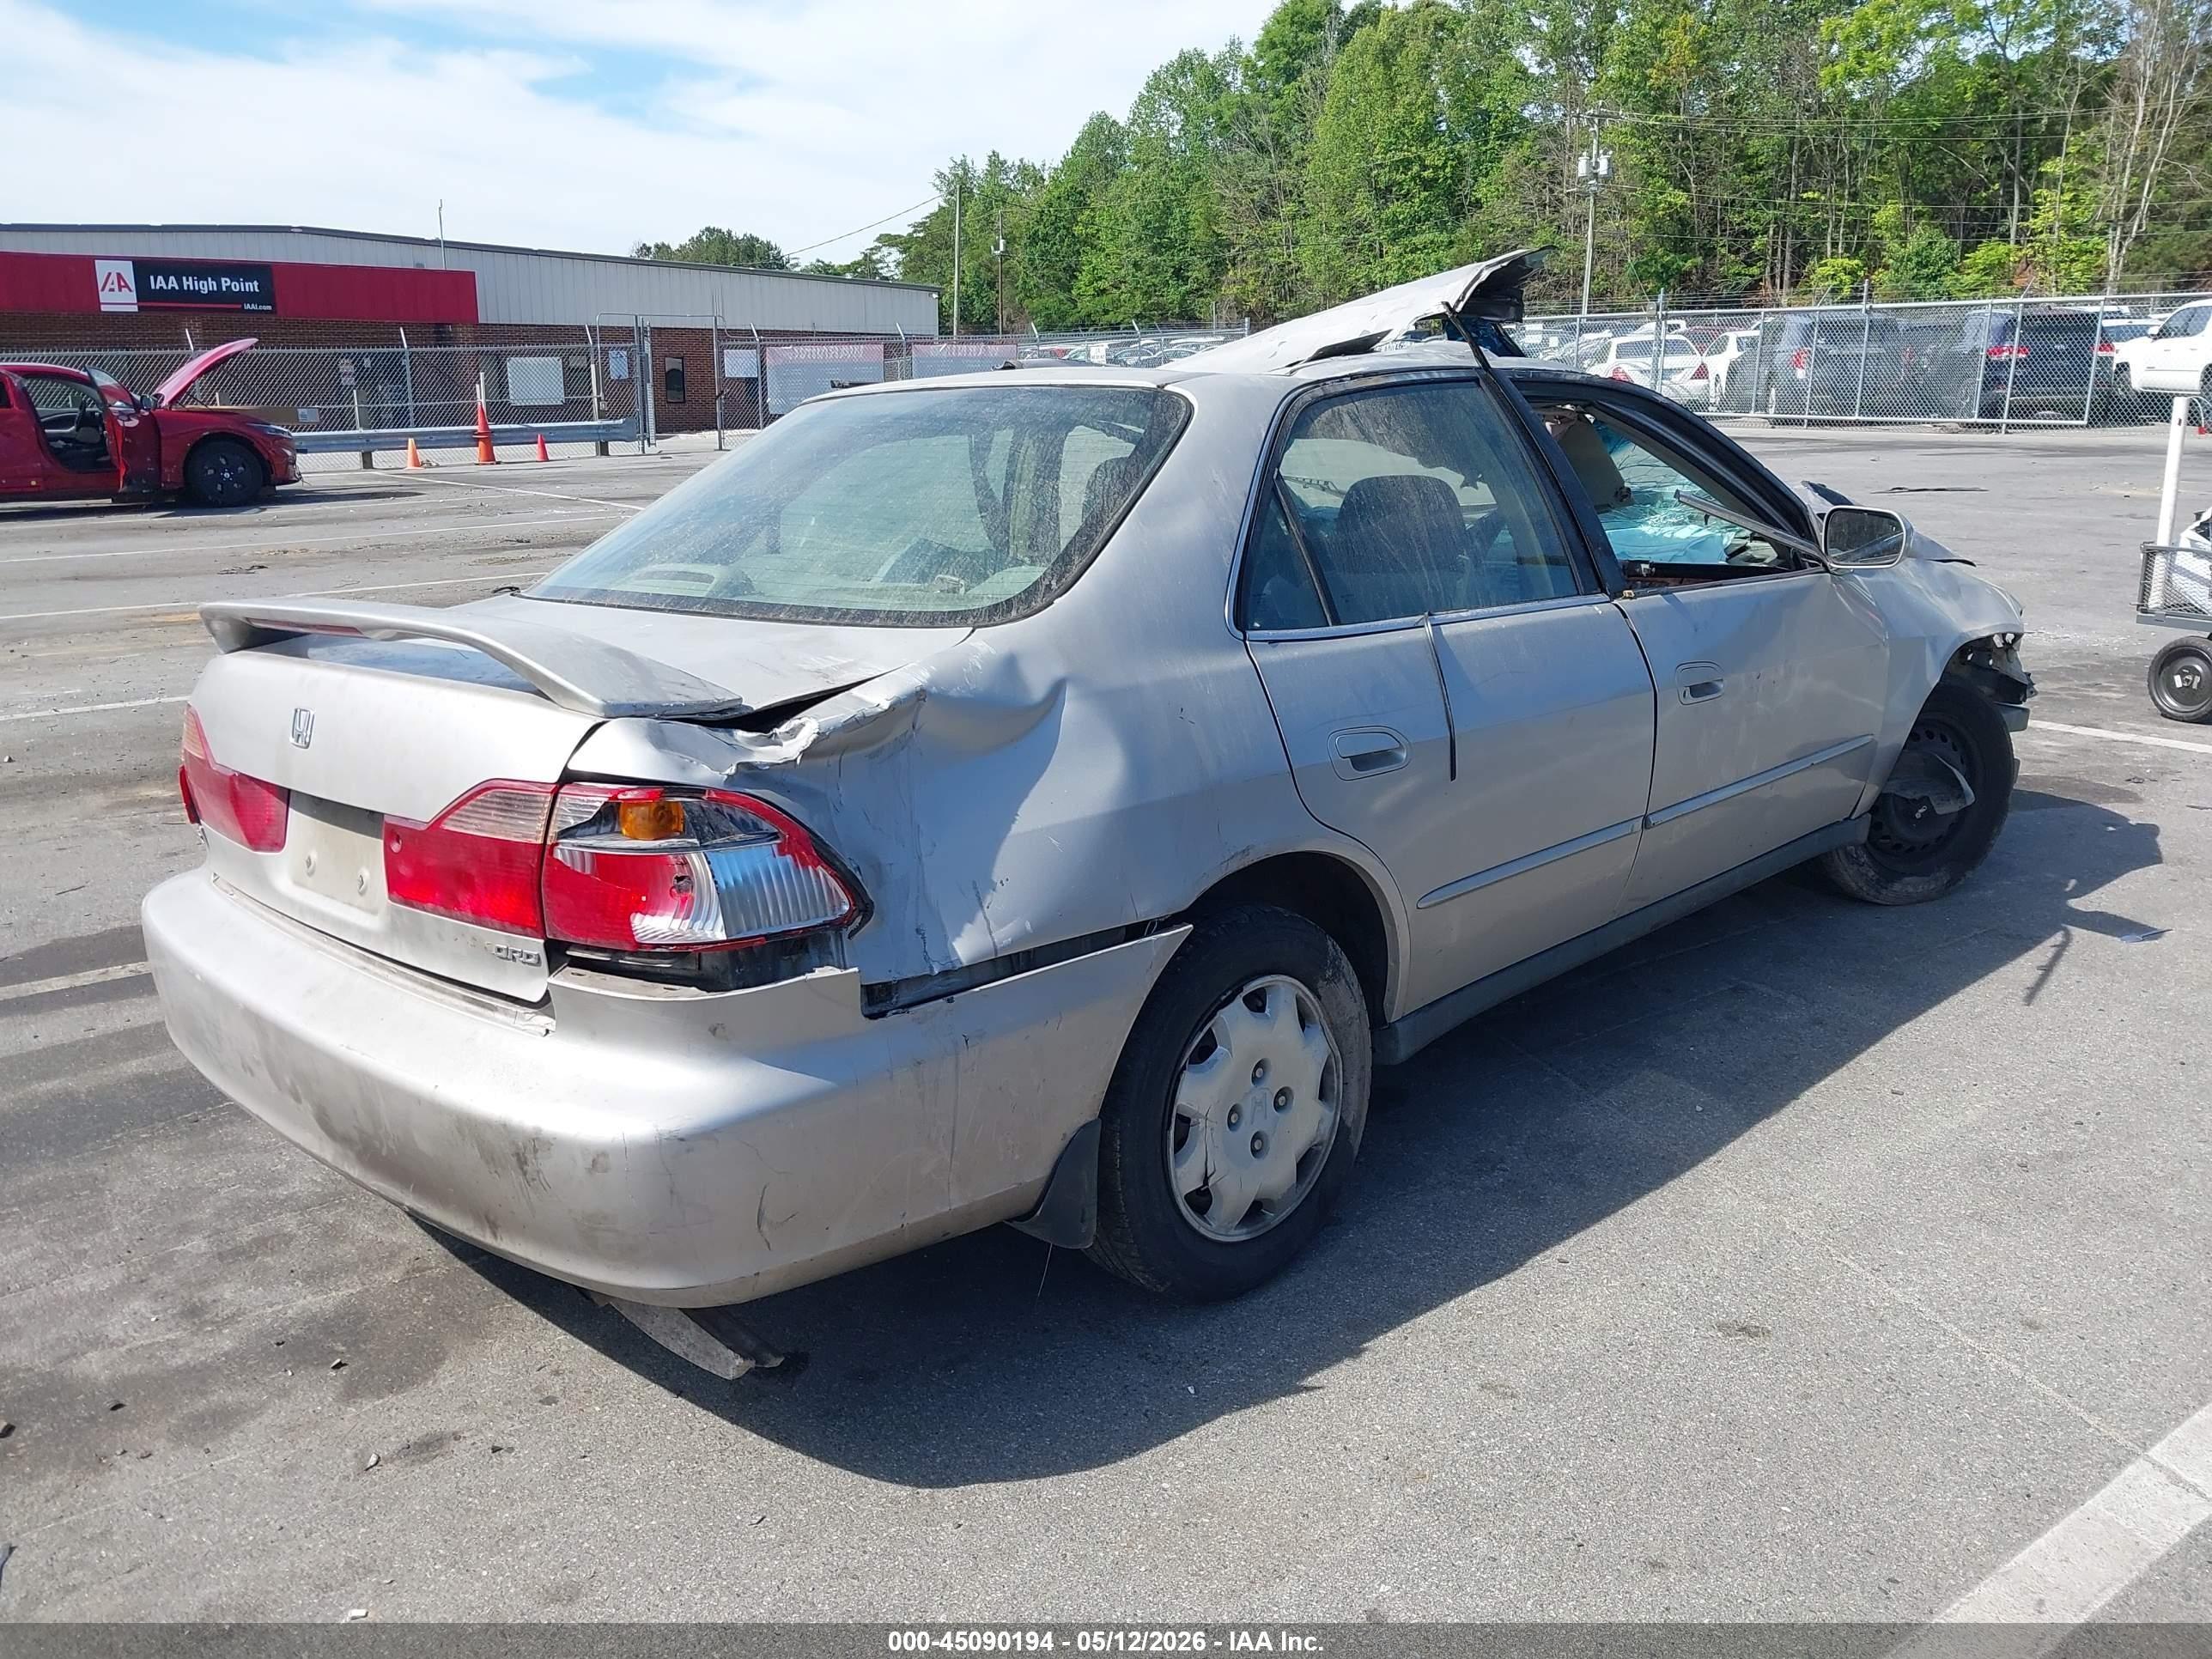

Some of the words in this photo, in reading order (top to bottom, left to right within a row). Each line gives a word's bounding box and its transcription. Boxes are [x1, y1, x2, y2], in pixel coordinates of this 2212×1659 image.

[149, 274, 179, 290] IAA
[183, 276, 217, 295] High
[221, 276, 260, 293] Point
